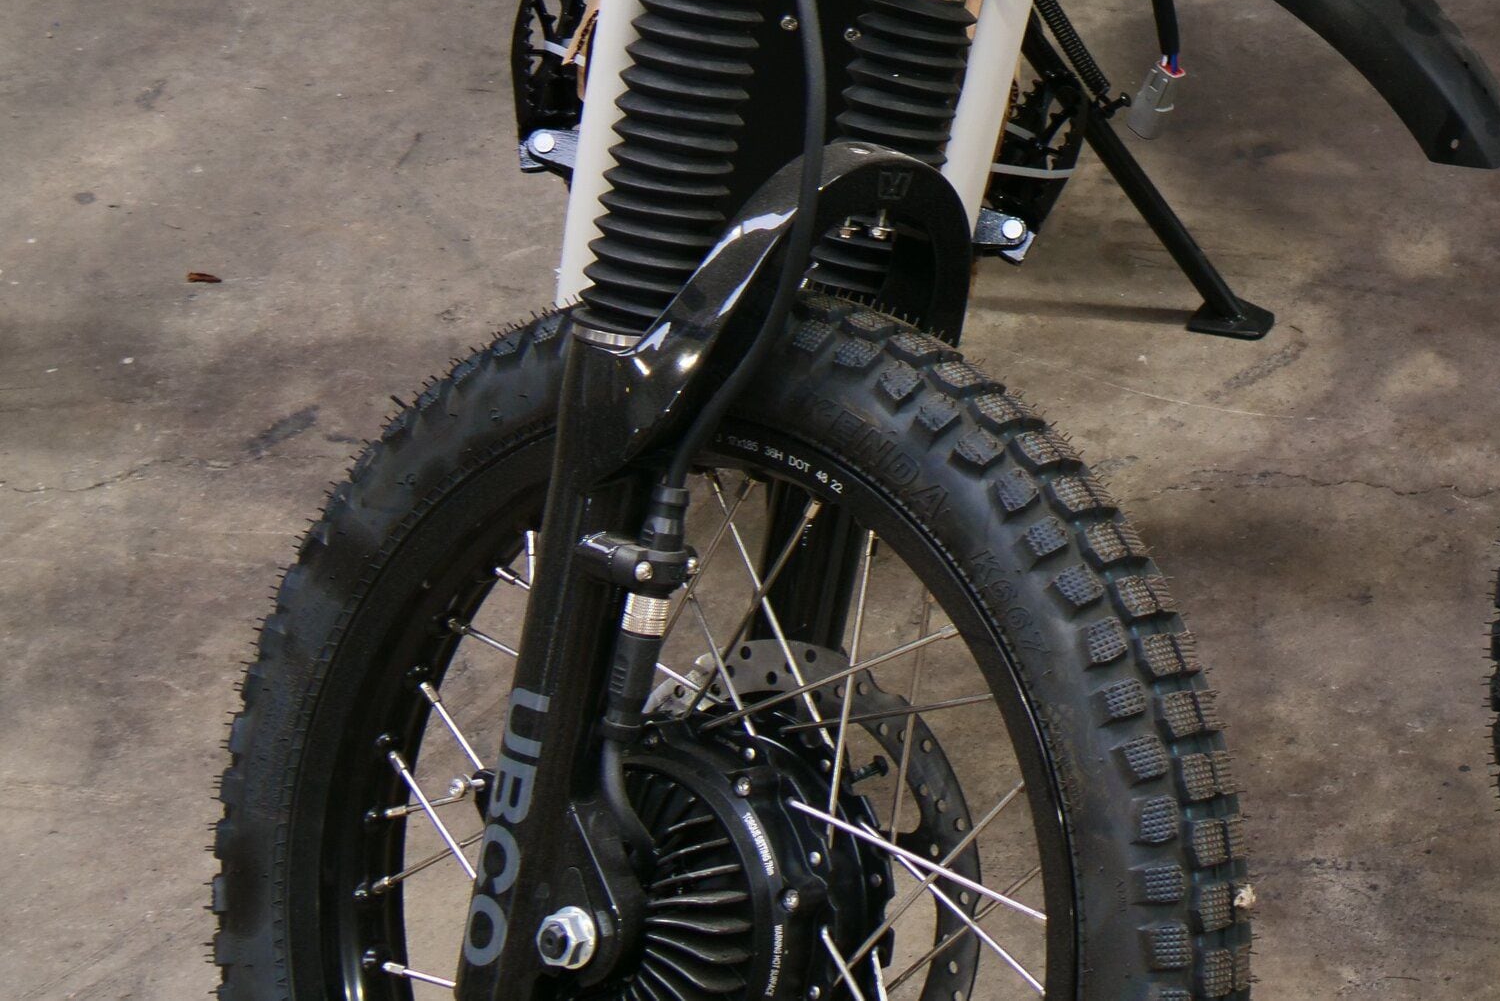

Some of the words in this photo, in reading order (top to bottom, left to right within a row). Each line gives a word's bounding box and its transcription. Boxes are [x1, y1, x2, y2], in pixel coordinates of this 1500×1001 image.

[787, 455, 811, 473] DOT
[829, 479, 844, 494] 22
[464, 687, 550, 966] UBCO
[743, 812, 762, 839] TORQUE
[754, 835, 771, 862] SETTING
[773, 924, 784, 955] WARNING
[772, 954, 782, 970] HOT
[764, 968, 780, 997] SURFACE
